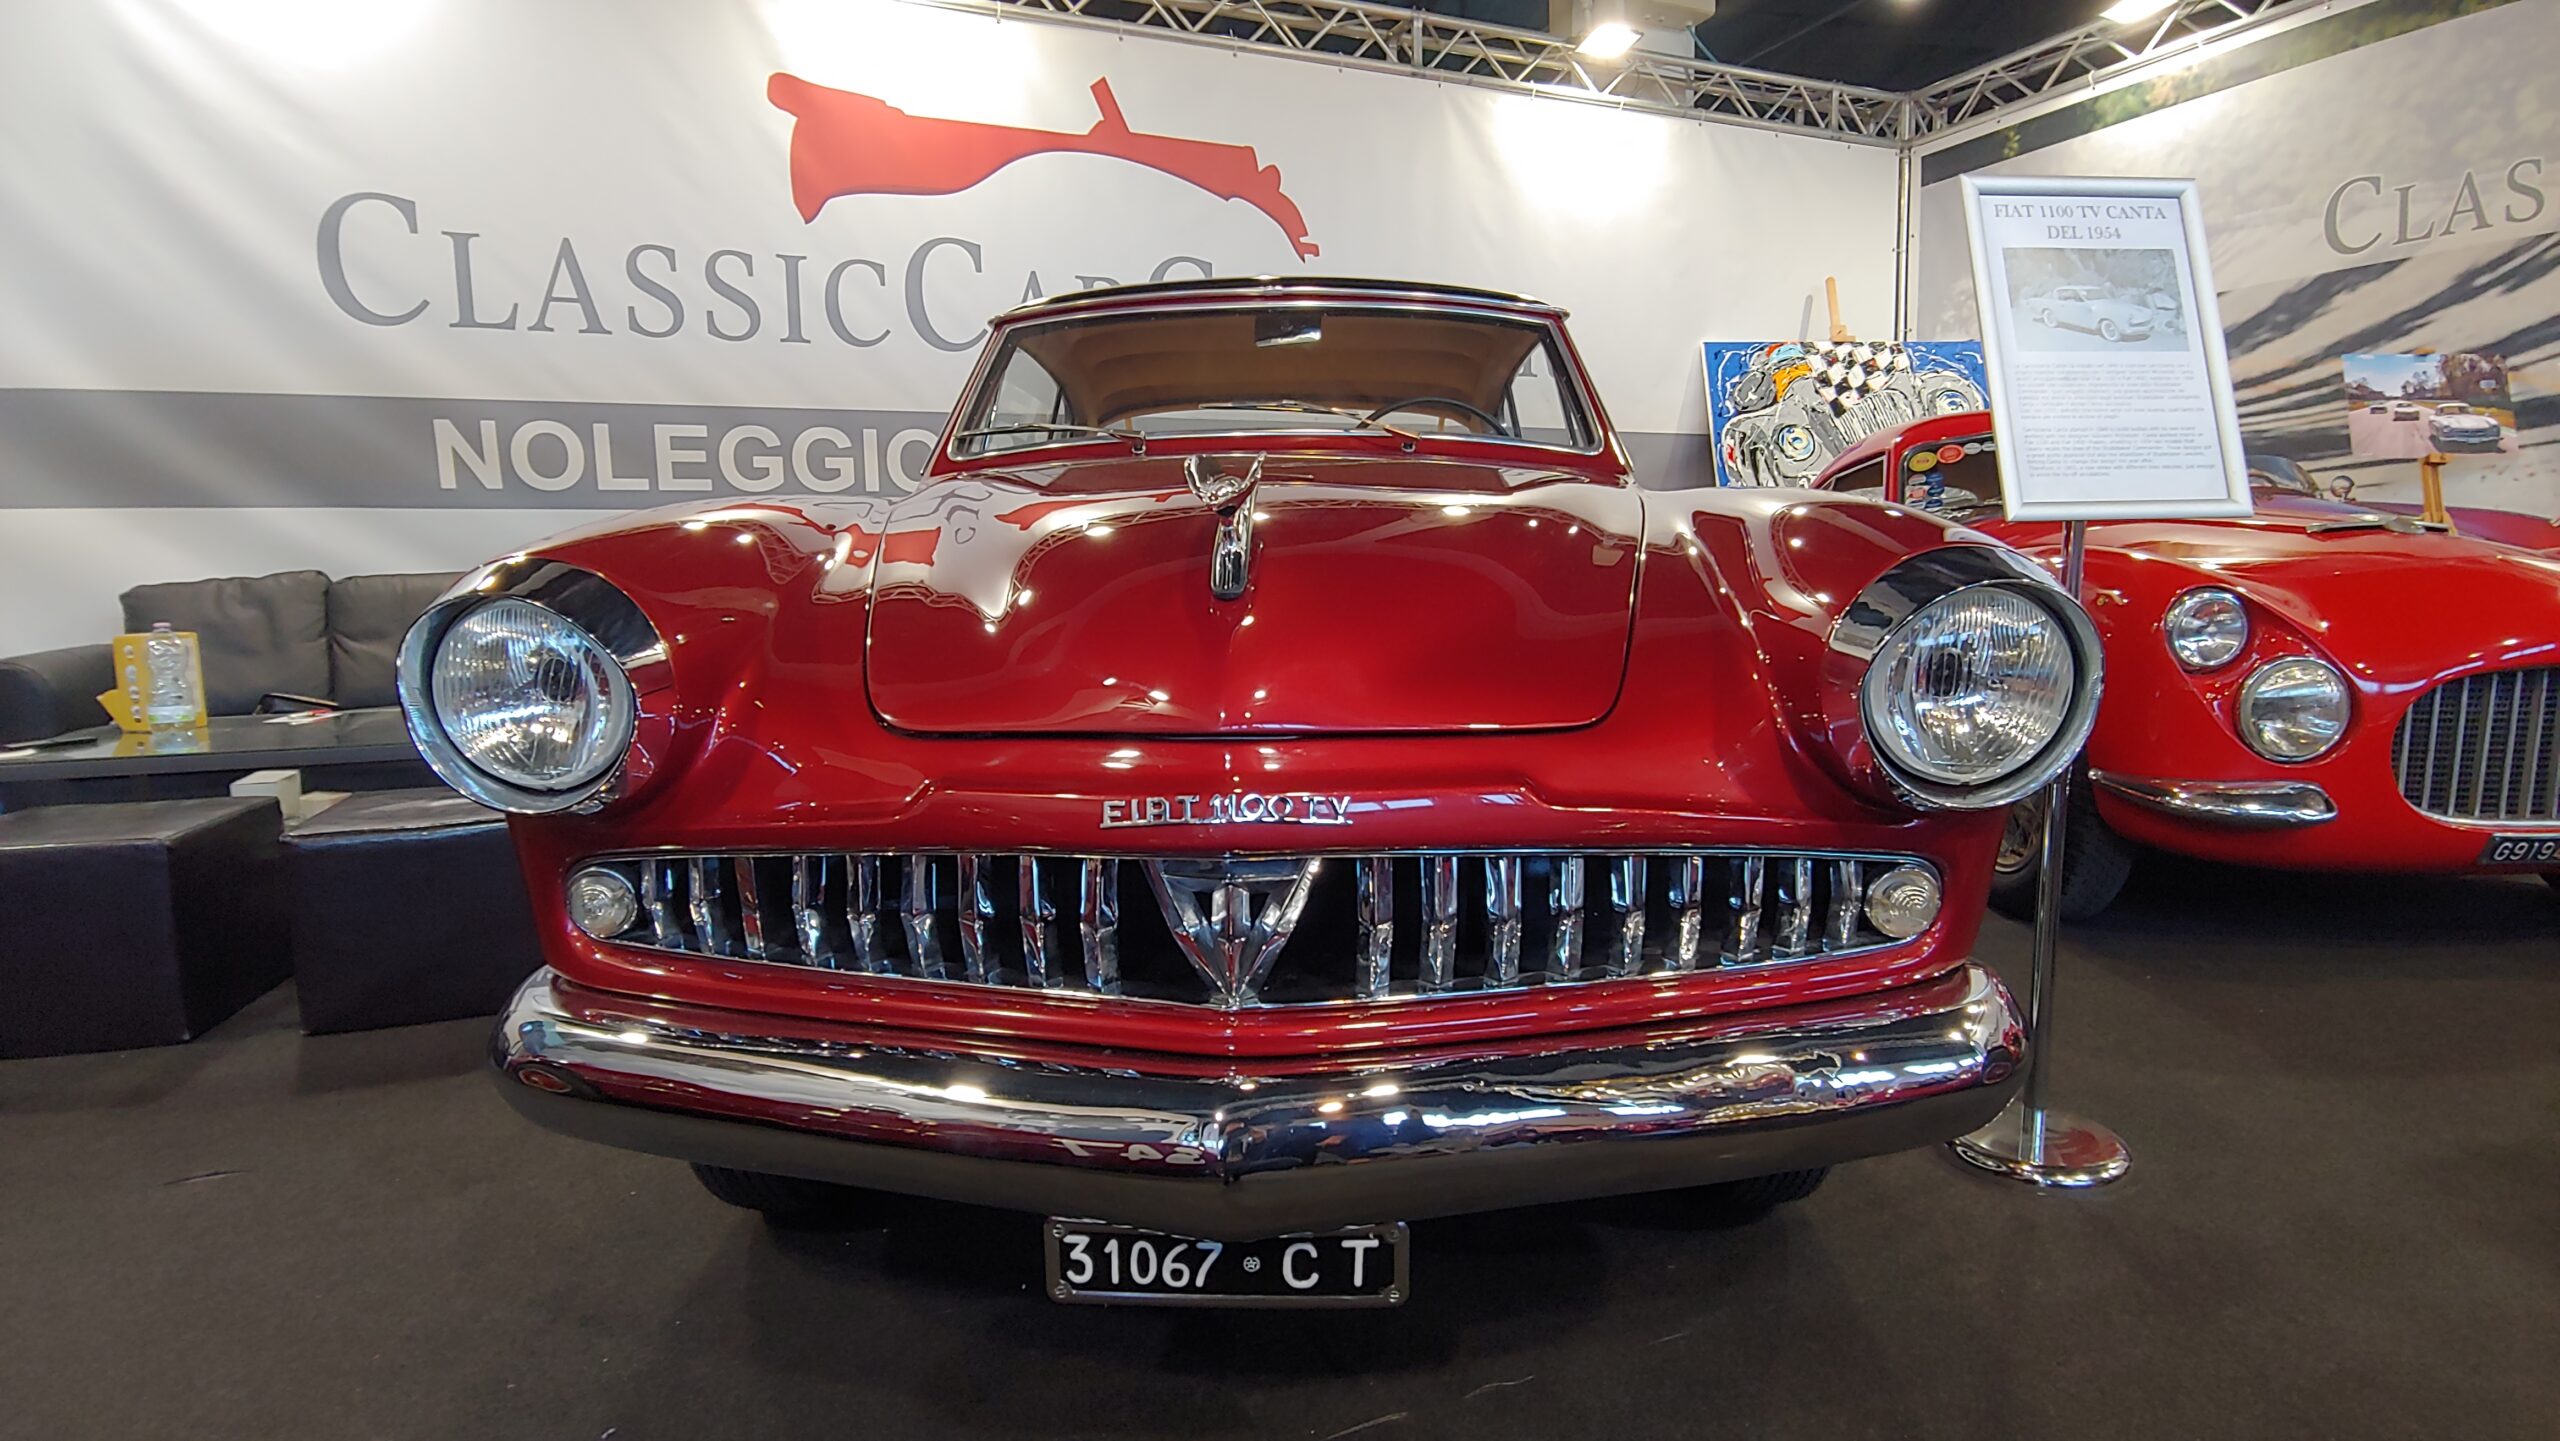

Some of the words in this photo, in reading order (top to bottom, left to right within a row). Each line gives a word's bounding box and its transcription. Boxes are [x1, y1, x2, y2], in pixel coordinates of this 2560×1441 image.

[1994, 204, 2034, 218] FIAT
[2040, 205, 2074, 218] 1100
[2076, 205, 2101, 219] TV
[2106, 205, 2168, 220] CANTA
[2047, 225, 2083, 239] DEL
[2087, 226, 2122, 240] 1954
[431, 418, 941, 493] NOLEGGIO
[1100, 795, 1200, 829] FIAT
[1209, 793, 1294, 824] 1100
[1299, 796, 1353, 825] TV
[1062, 1234, 1224, 1288] 31067
